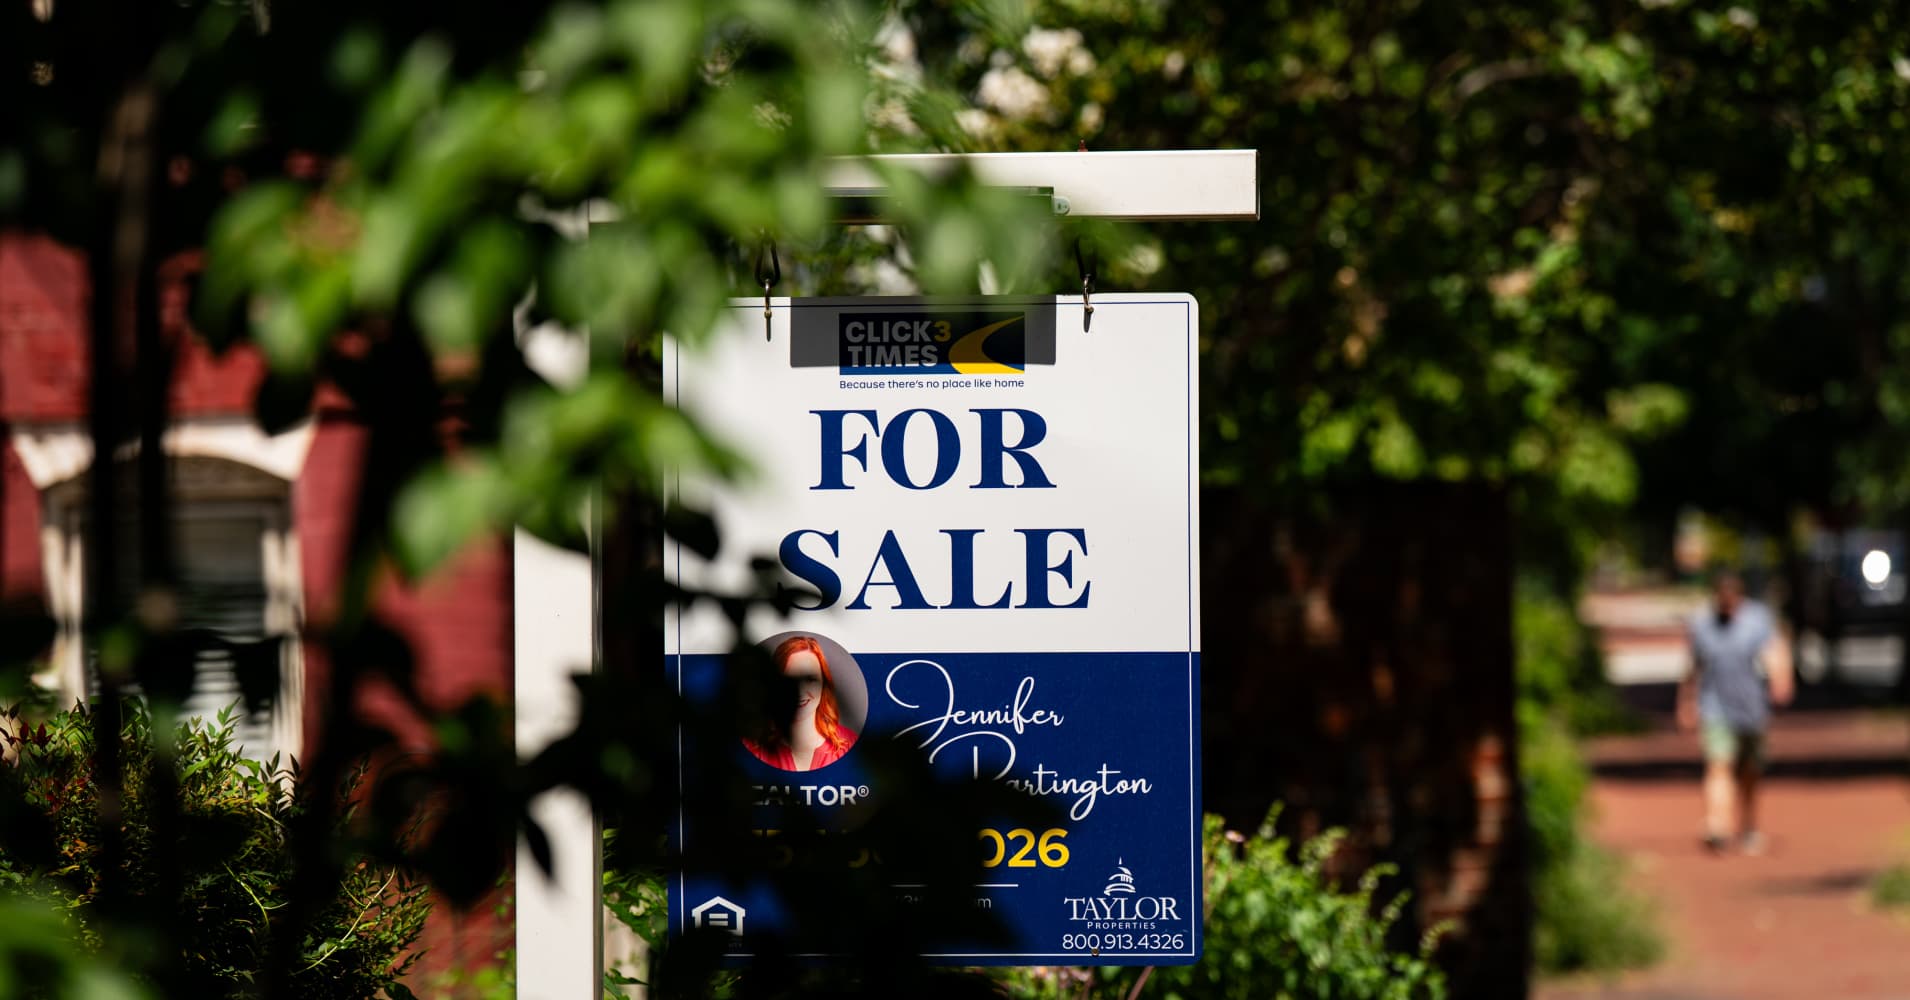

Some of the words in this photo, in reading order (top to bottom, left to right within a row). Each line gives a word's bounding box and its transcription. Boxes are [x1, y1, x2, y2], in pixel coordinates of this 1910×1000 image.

[848, 345, 938, 367] TIMES
[839, 381, 885, 389] Because
[887, 380, 924, 389] there's
[926, 380, 939, 389] no
[942, 379, 972, 391] place
[974, 378, 992, 388] like
[994, 379, 1025, 388] home
[809, 408, 1057, 490] FOR
[779, 528, 1091, 611] SALE
[886, 659, 1064, 749] Jennifer
[928, 731, 1153, 821] Partington
[1064, 897, 1181, 921] TAYLOR
[1087, 921, 1156, 930] PROPERTIES
[1061, 934, 1185, 950] 800.913.4326
